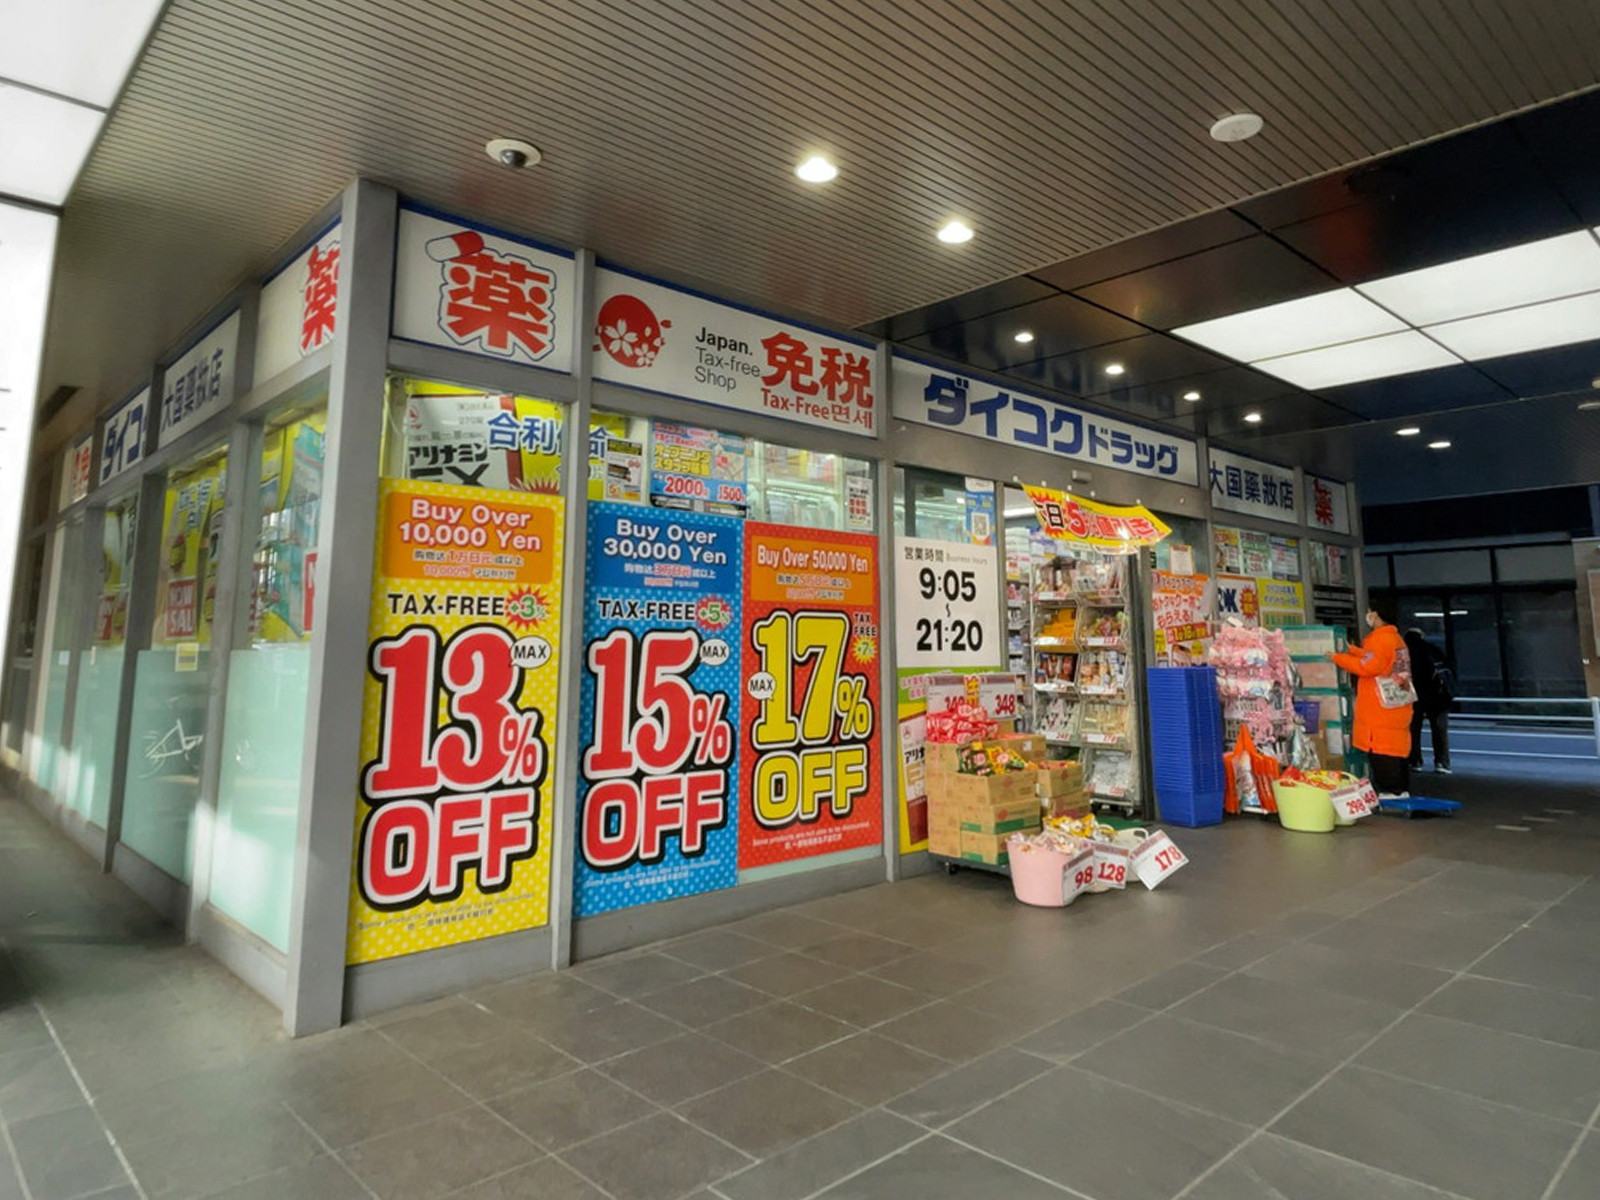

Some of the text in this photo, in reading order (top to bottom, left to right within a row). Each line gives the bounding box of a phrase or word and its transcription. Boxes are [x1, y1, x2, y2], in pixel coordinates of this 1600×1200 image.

[446, 253, 551, 353] 薬
[696, 327, 753, 355] Japan.
[696, 346, 760, 378] Tax-free
[761, 331, 874, 409] 免税
[695, 366, 737, 392] Shop
[488, 413, 559, 452] 合利
[924, 374, 1178, 475] ダイコクドラッグ
[103, 404, 146, 480] ダイコ
[411, 498, 531, 527] Buy Over
[400, 521, 541, 551] 10,000 Yen
[616, 519, 717, 544] Buy Over
[604, 538, 727, 564] 30,000 Yen
[757, 545, 868, 572] Buy Over 50,000 Yen
[919, 567, 976, 602] 9:05
[387, 594, 505, 615] TAX-FREE
[598, 599, 696, 621] TAX-FREE
[854, 612, 871, 623] TAX
[854, 626, 876, 637] FREE
[916, 619, 983, 652] 21:20
[513, 645, 547, 659] MAX
[701, 646, 727, 658] MAX
[749, 680, 773, 692] MAX
[755, 613, 870, 746] 17%
[368, 630, 540, 795] 13%
[587, 633, 729, 773] 15%
[995, 694, 1015, 715] 348
[756, 746, 866, 823] OFF
[585, 771, 724, 864] OFF
[366, 790, 533, 900] OFF
[1155, 846, 1182, 871] 178
[1075, 866, 1094, 889] 98
[1098, 862, 1126, 883] 128
